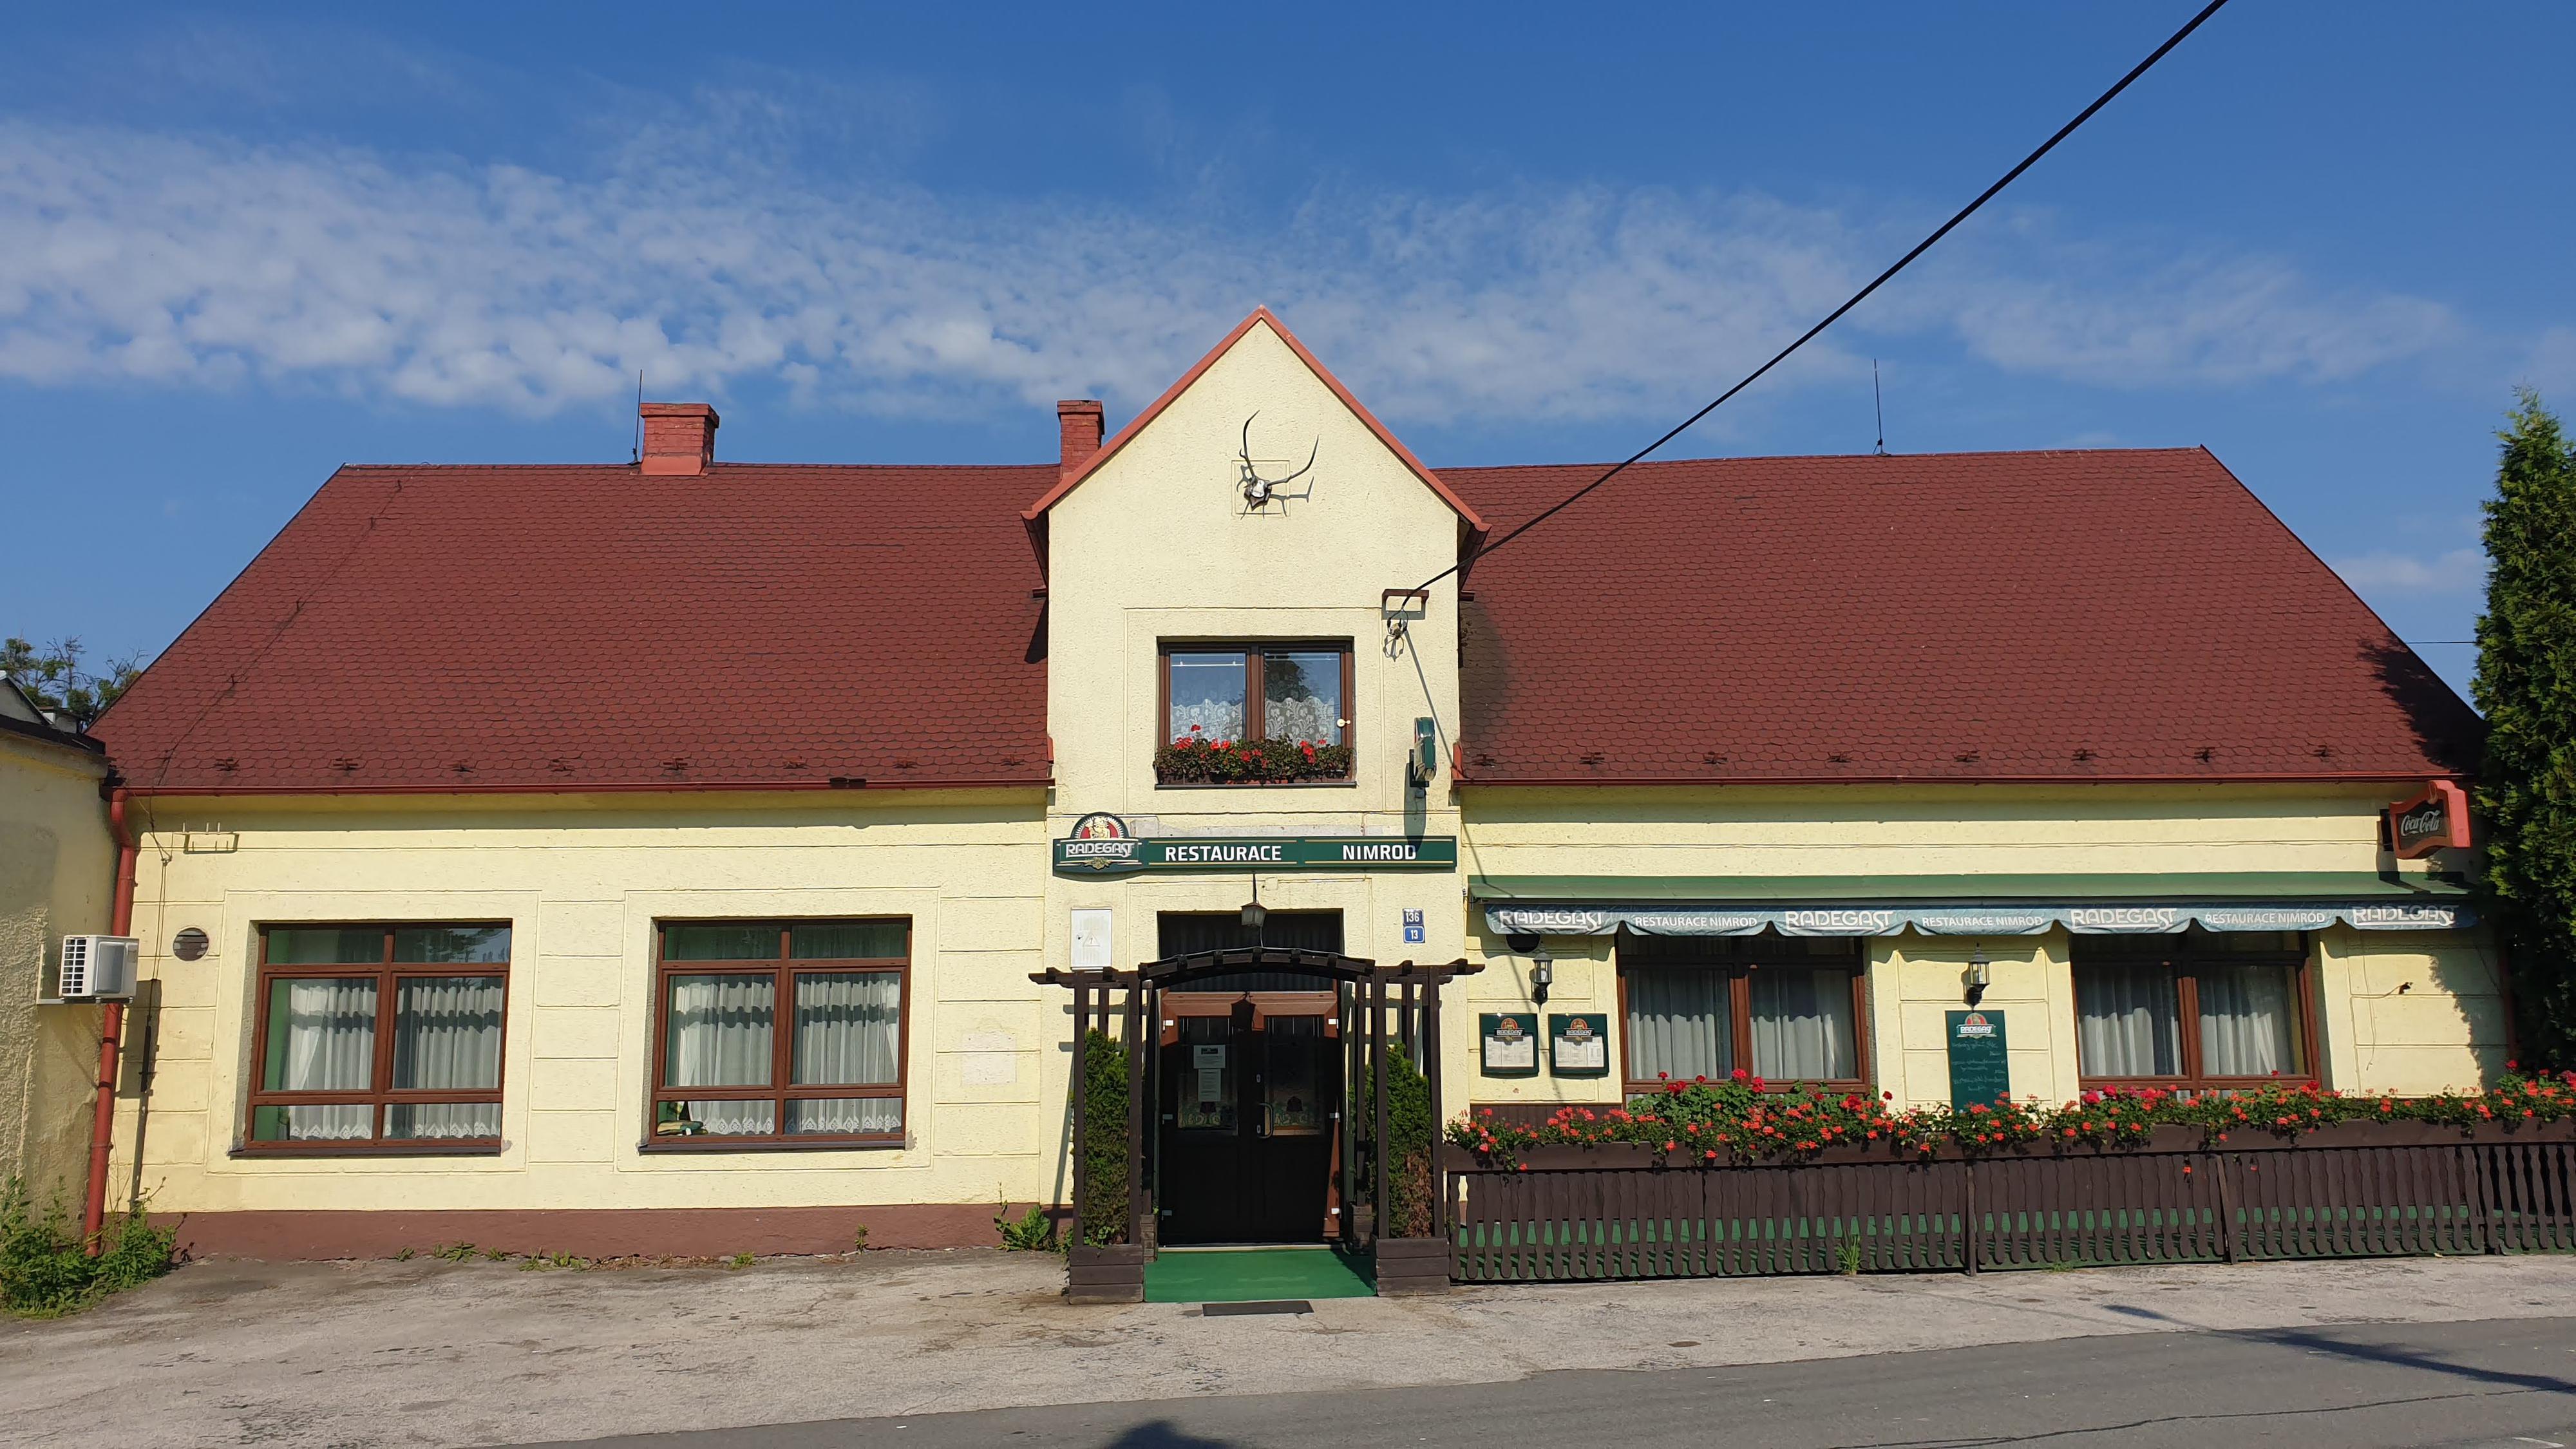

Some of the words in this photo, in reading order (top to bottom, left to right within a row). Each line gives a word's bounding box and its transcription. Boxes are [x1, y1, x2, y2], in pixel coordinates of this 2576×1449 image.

[1065, 842, 1135, 857] RADEGAST
[1165, 846, 1282, 862] RESTAURACE
[1343, 844, 1416, 860] NIMROD
[1405, 912, 1420, 922] 136
[1499, 909, 1604, 929] RADEGAST
[1635, 916, 1707, 927] RESTAURACE
[1709, 916, 1757, 927] NIMROD
[1785, 910, 1894, 932] RADEGAST
[1922, 916, 1993, 927] RESTAURACE
[1996, 916, 2043, 926] NIMROD
[2070, 908, 2177, 929] RADEGAST
[2205, 913, 2275, 924] RESTAURACE
[2278, 913, 2325, 923] NIMROD
[2352, 904, 2459, 926] RADEGAST
[1410, 929, 1418, 940] 13
